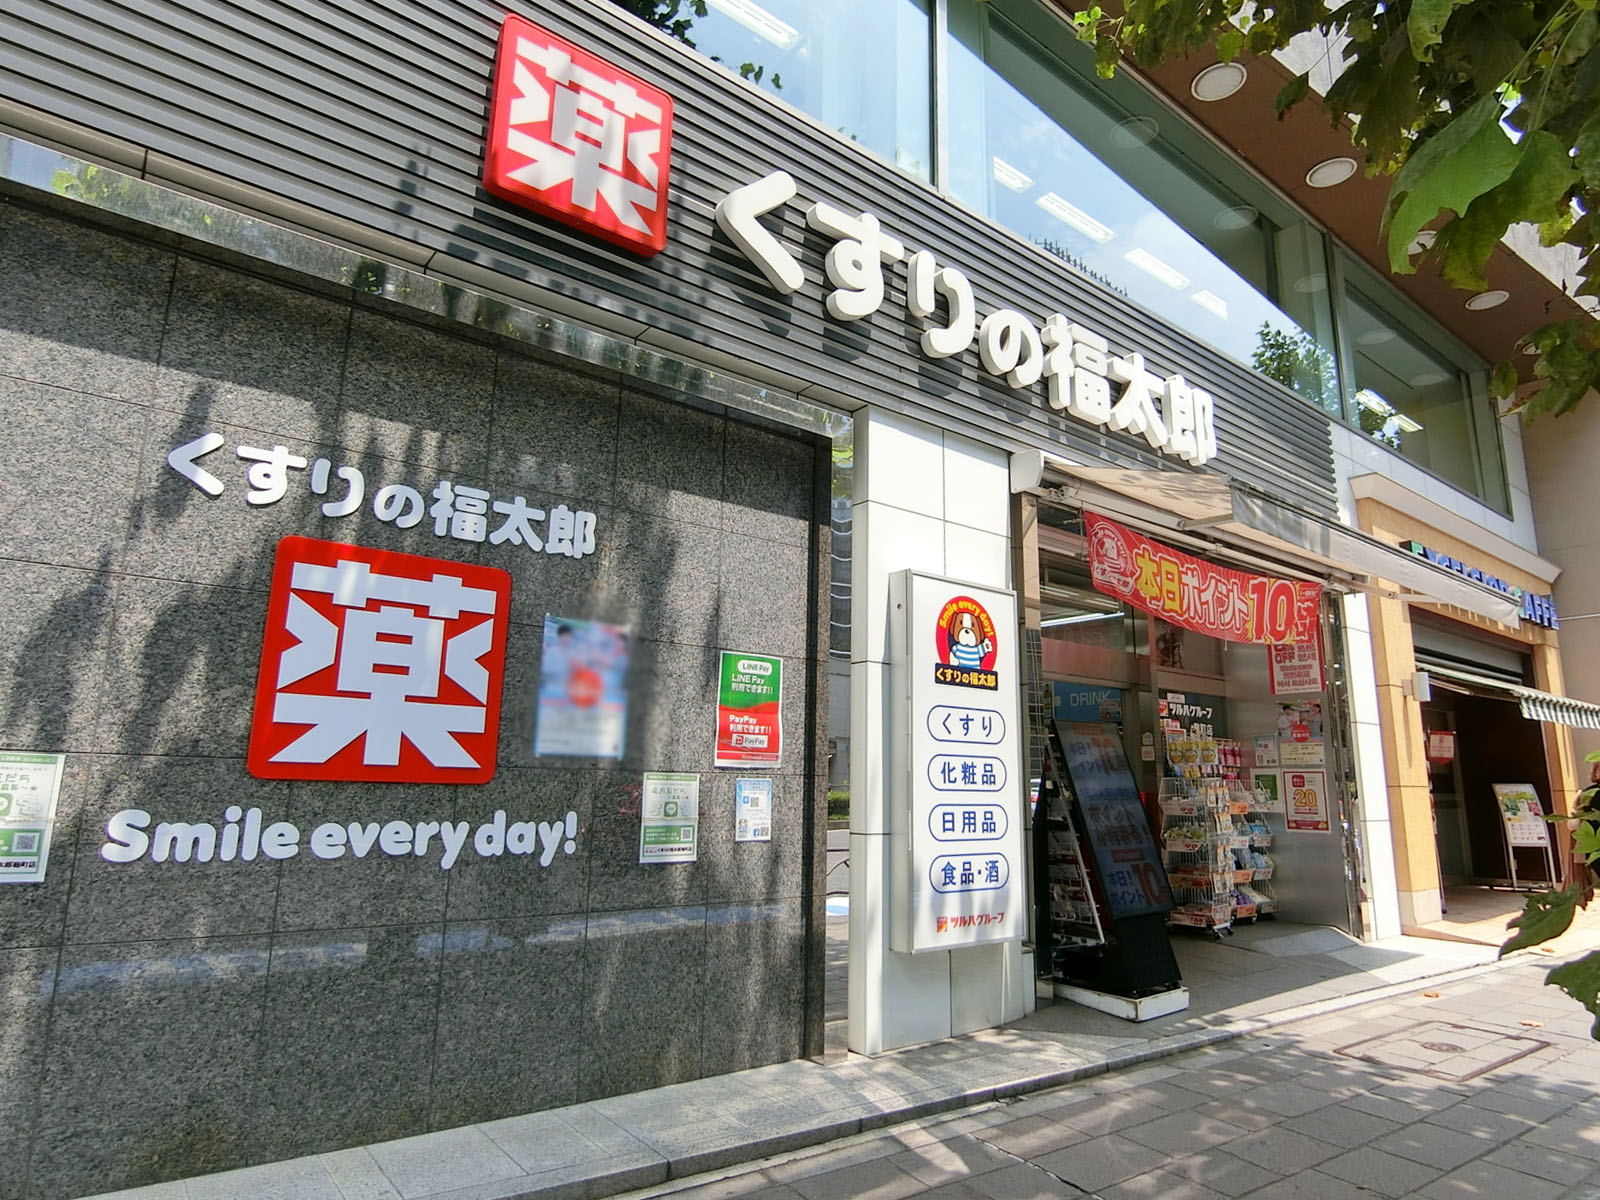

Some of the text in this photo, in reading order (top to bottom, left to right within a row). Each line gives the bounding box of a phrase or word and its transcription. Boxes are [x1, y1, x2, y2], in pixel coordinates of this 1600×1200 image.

[714, 169, 1217, 467] くすりの福太郎
[167, 431, 598, 560] くすりの福太郎
[939, 601, 995, 637] Smile every day!
[731, 673, 765, 685] LINE Pay
[742, 663, 758, 671] LINE
[936, 667, 996, 688] くすりの福太郎
[1070, 690, 1111, 707] DRINK
[729, 714, 757, 725] PayPay
[942, 712, 992, 738] くすり
[940, 761, 997, 786] 化粧品
[942, 810, 997, 834] 日用品
[101, 806, 578, 870] Smile every day!
[950, 911, 1005, 929] ツルハグループ
